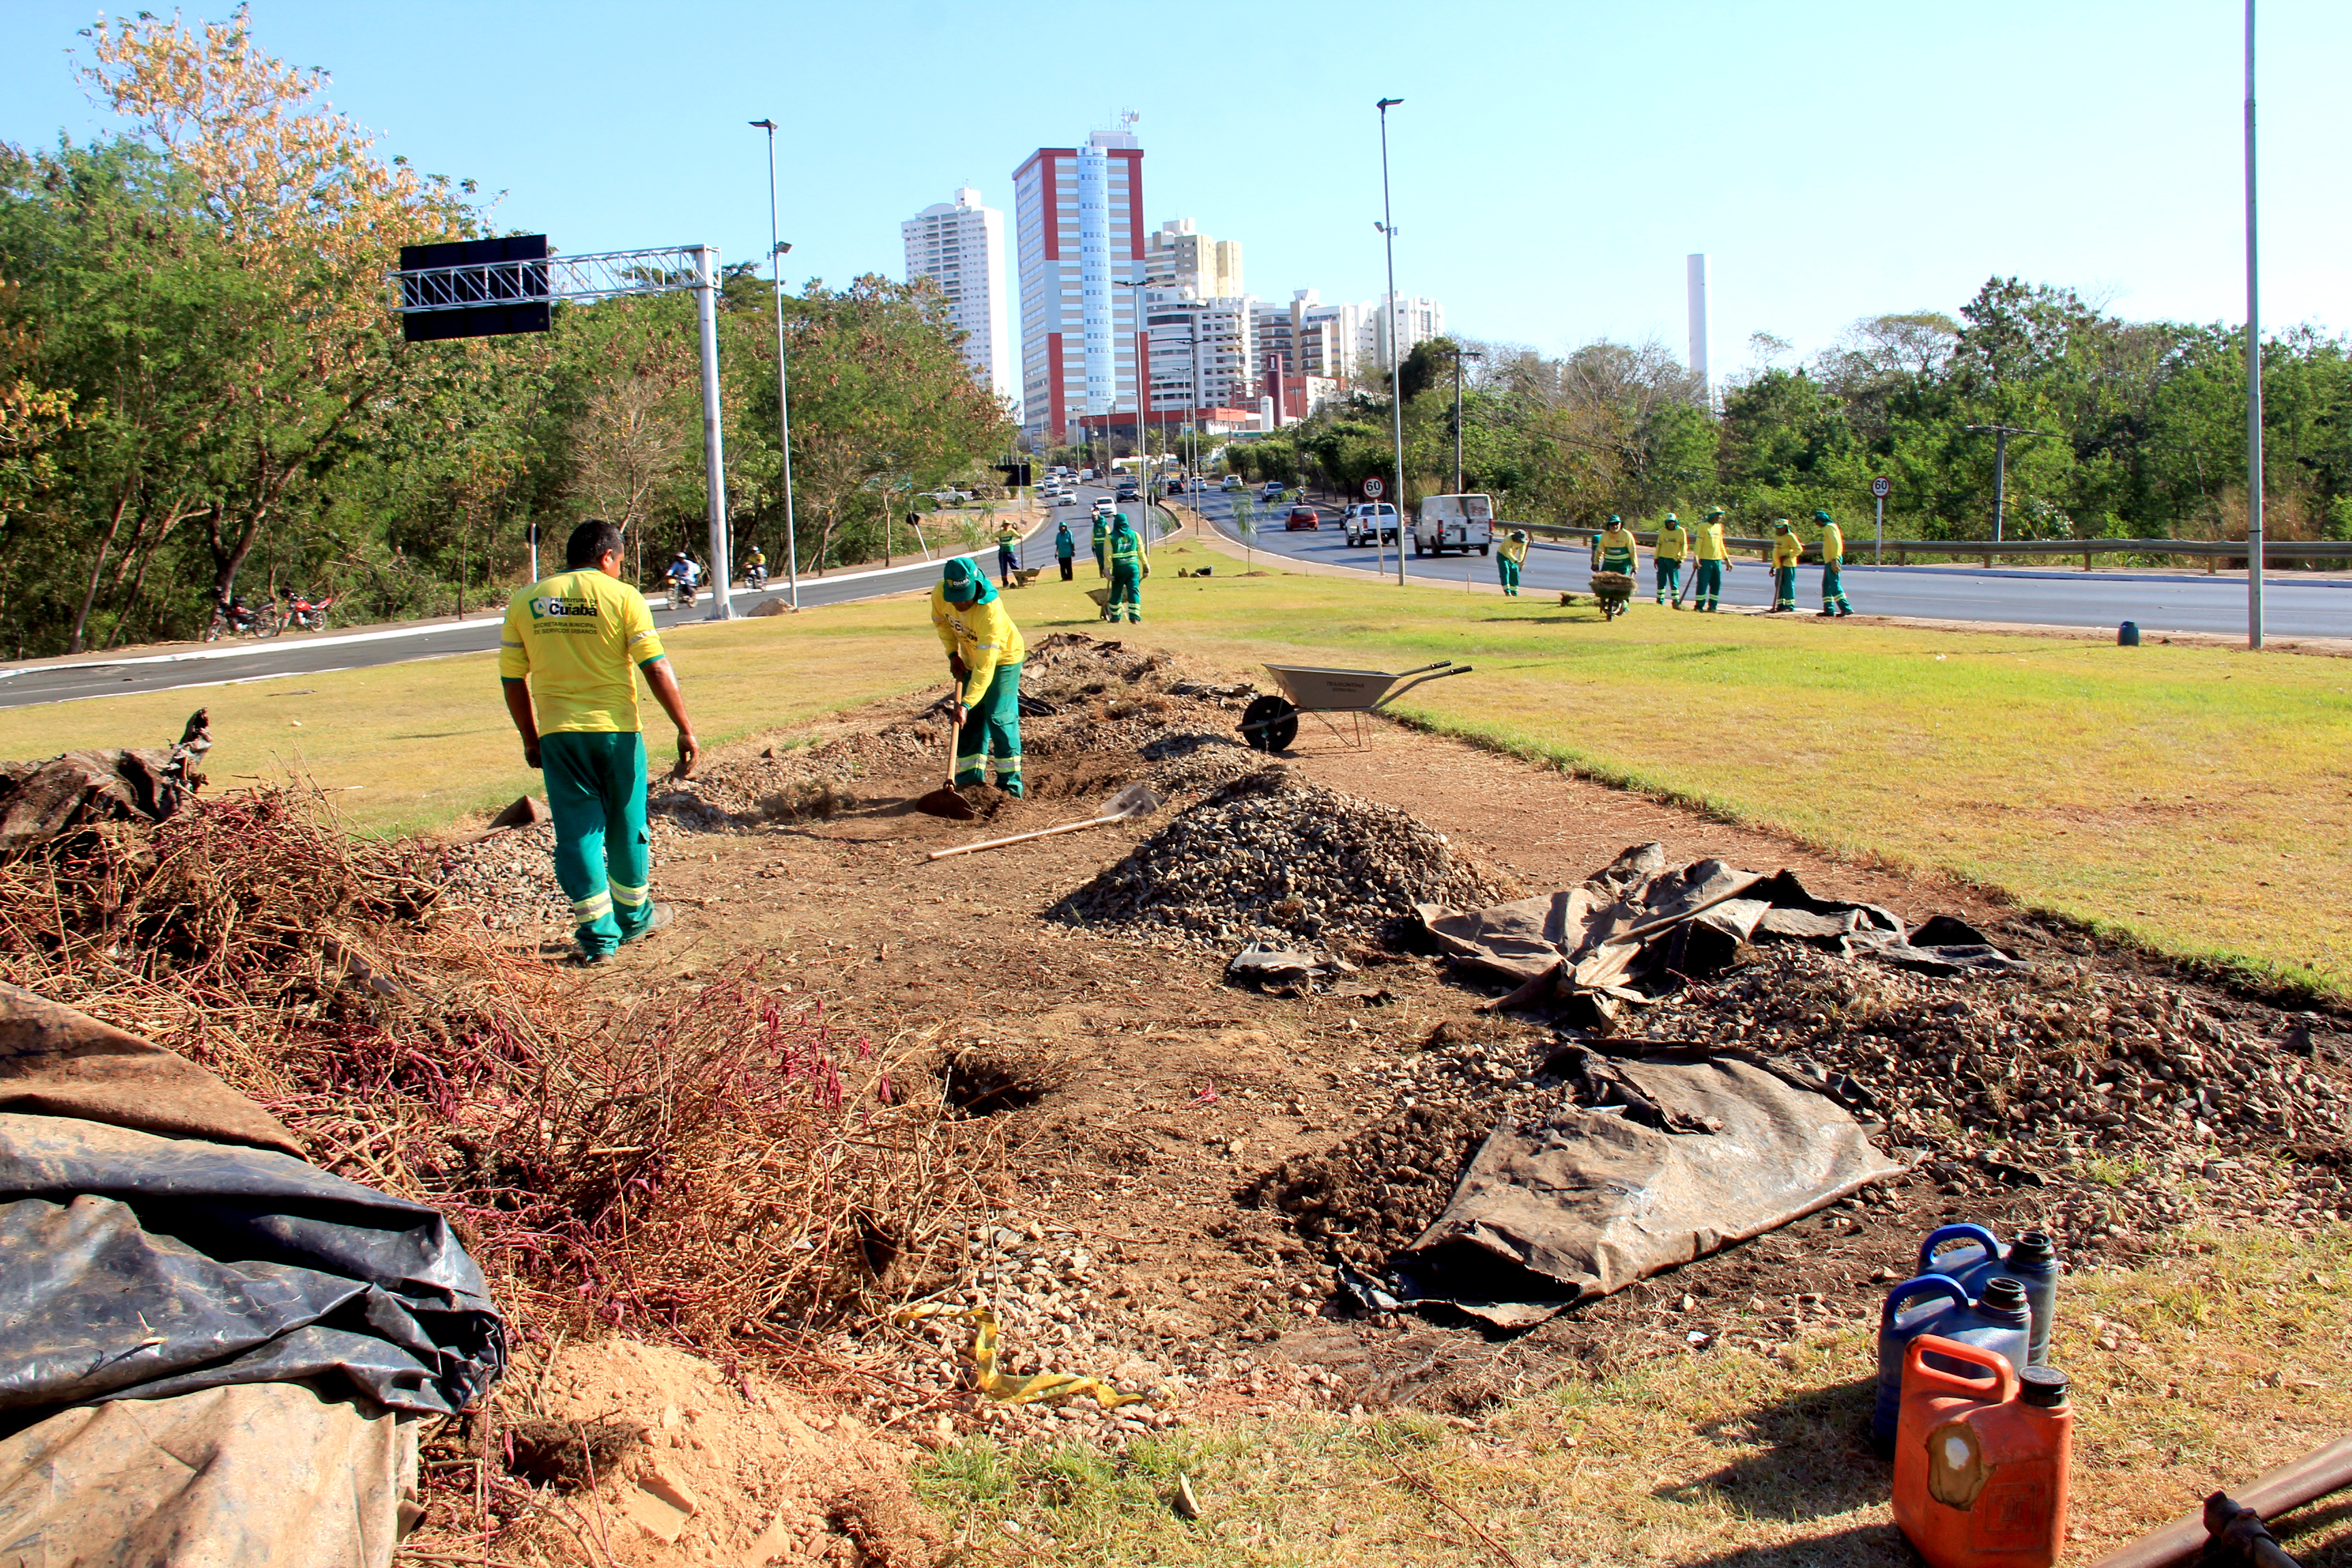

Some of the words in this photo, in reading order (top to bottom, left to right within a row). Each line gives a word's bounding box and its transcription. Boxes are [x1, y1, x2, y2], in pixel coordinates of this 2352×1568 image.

[1366, 480, 1380, 491] 60
[1875, 480, 1887, 490] 60
[549, 604, 598, 617] Cuiabá
